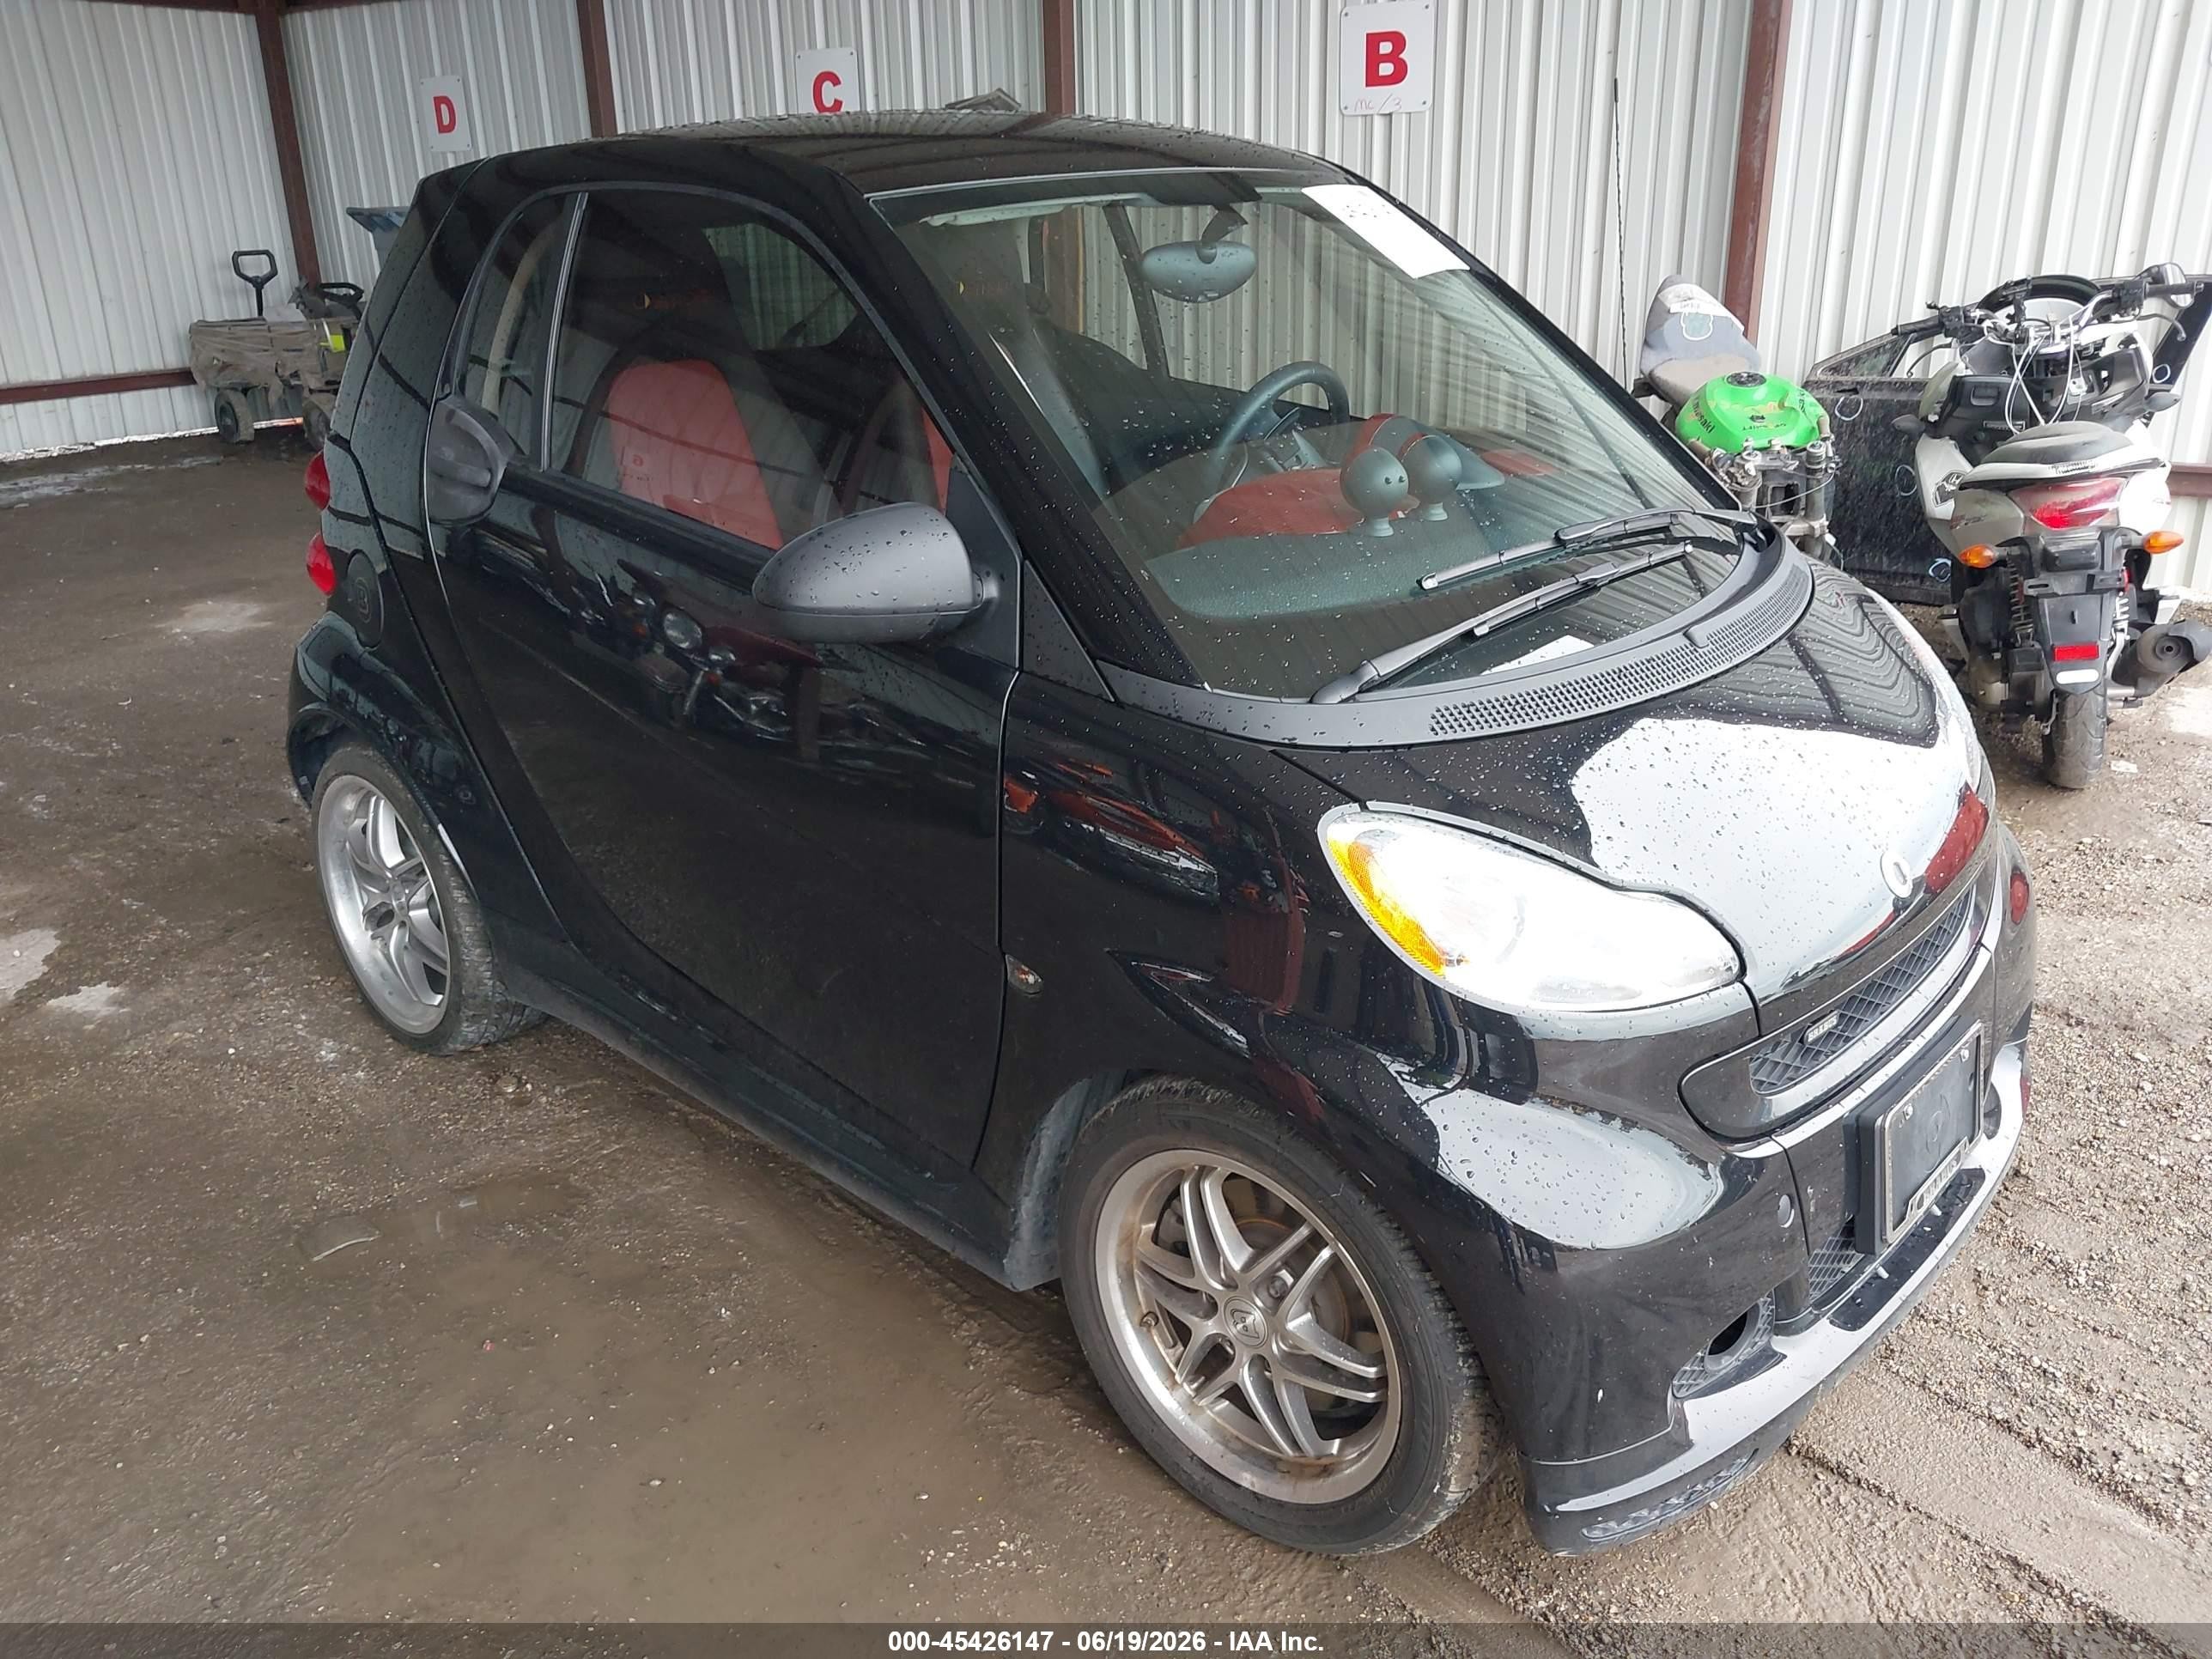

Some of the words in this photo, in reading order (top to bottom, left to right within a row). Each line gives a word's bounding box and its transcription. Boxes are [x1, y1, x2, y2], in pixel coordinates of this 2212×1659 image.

[1364, 31, 1408, 88] B
[812, 70, 843, 113] C
[433, 95, 456, 134] D
